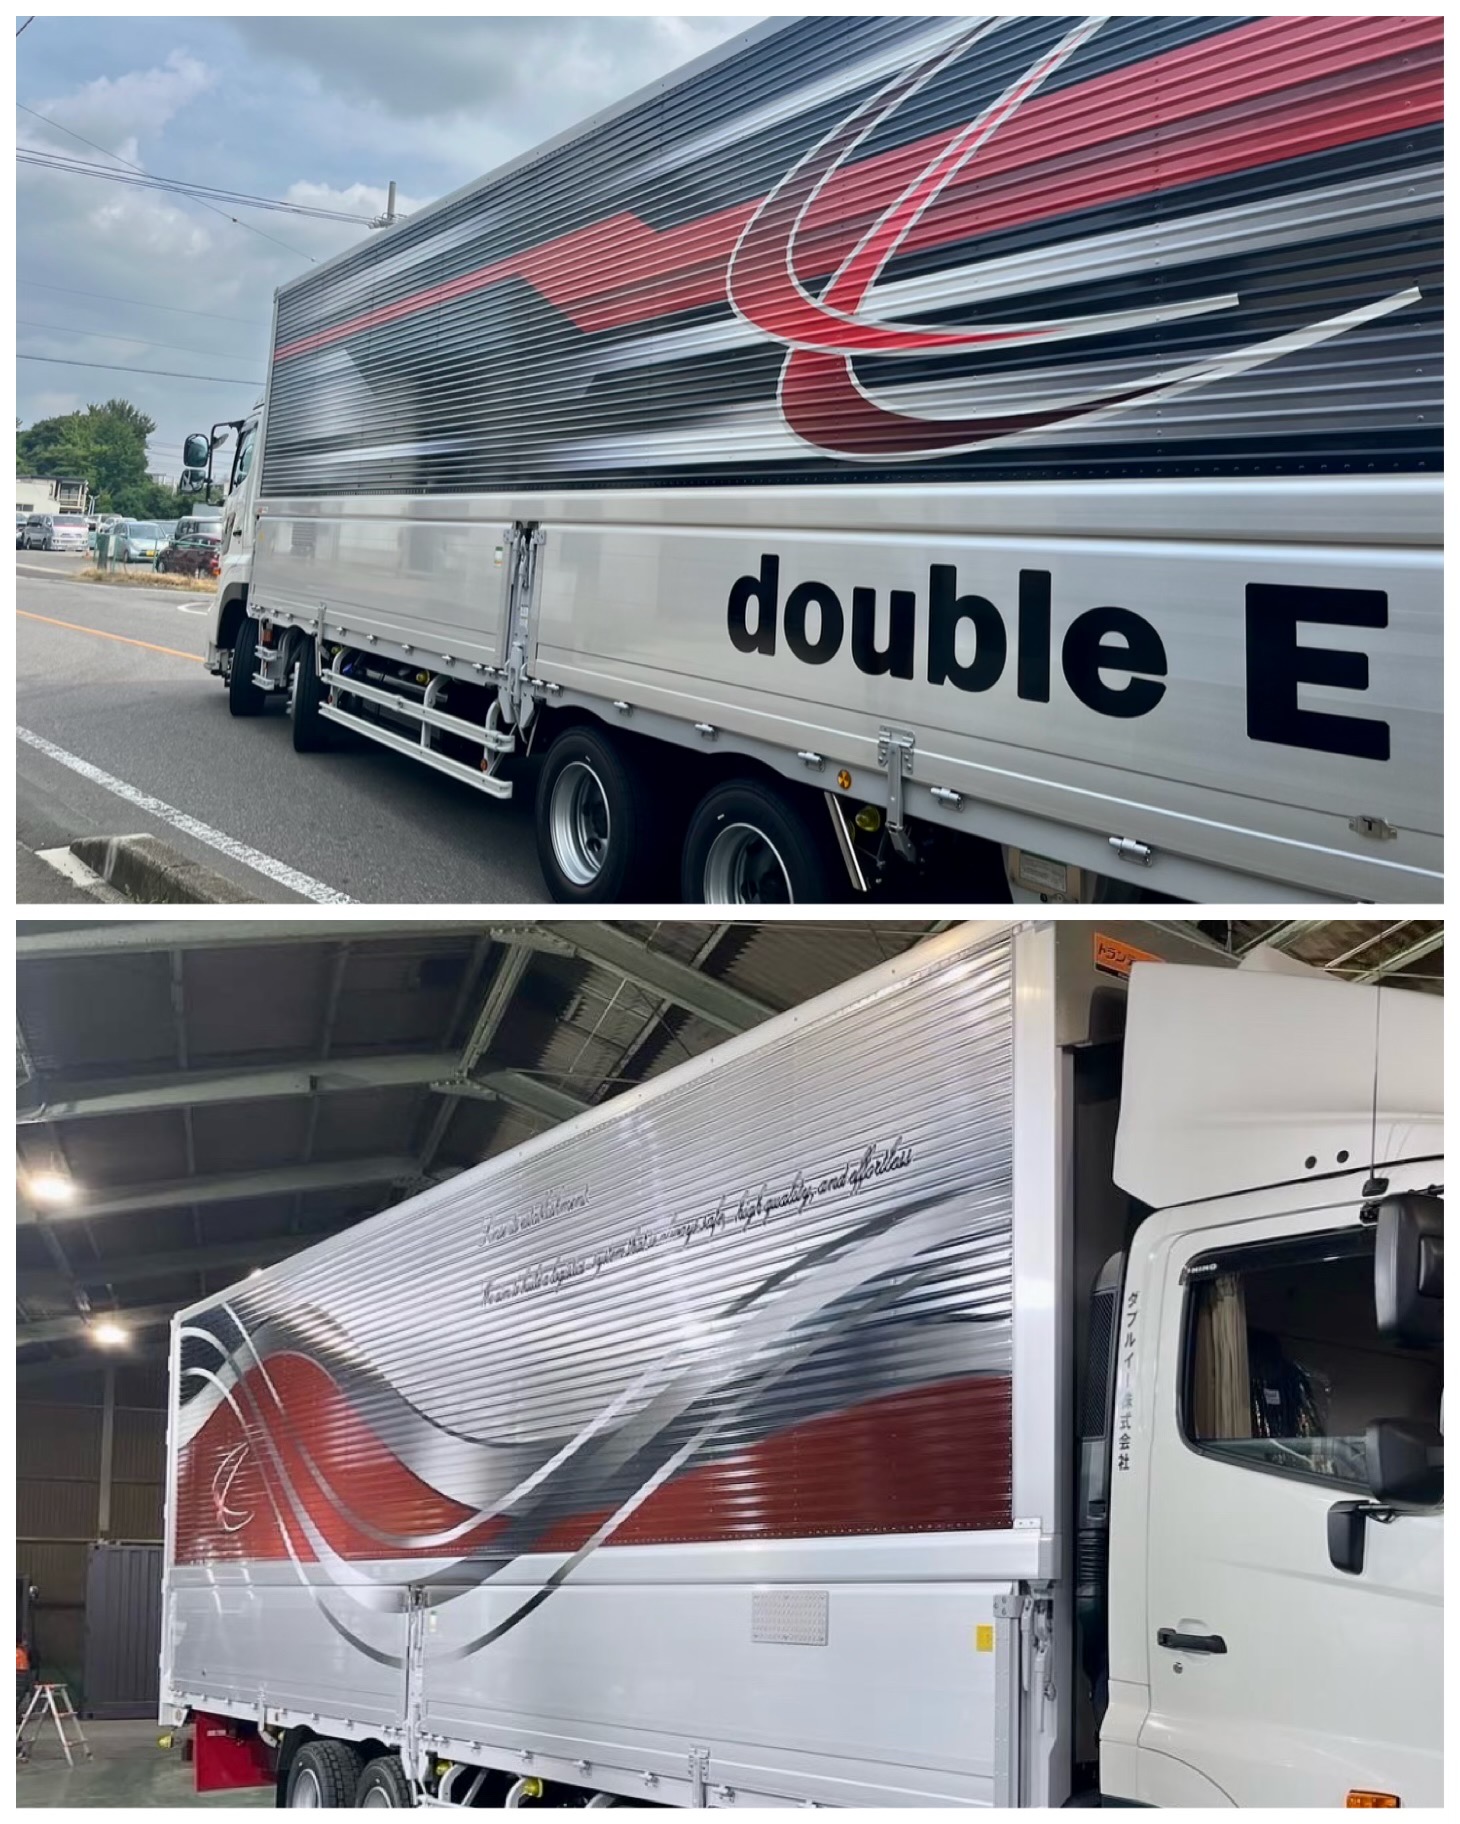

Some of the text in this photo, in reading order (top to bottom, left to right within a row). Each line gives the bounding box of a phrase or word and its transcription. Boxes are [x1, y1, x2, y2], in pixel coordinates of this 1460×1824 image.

[728, 553, 1391, 762] double E
[1098, 943, 1136, 966] トランテ
[816, 1163, 849, 1194] and
[849, 1136, 913, 1195] effortless
[1192, 1263, 1217, 1273] HINO
